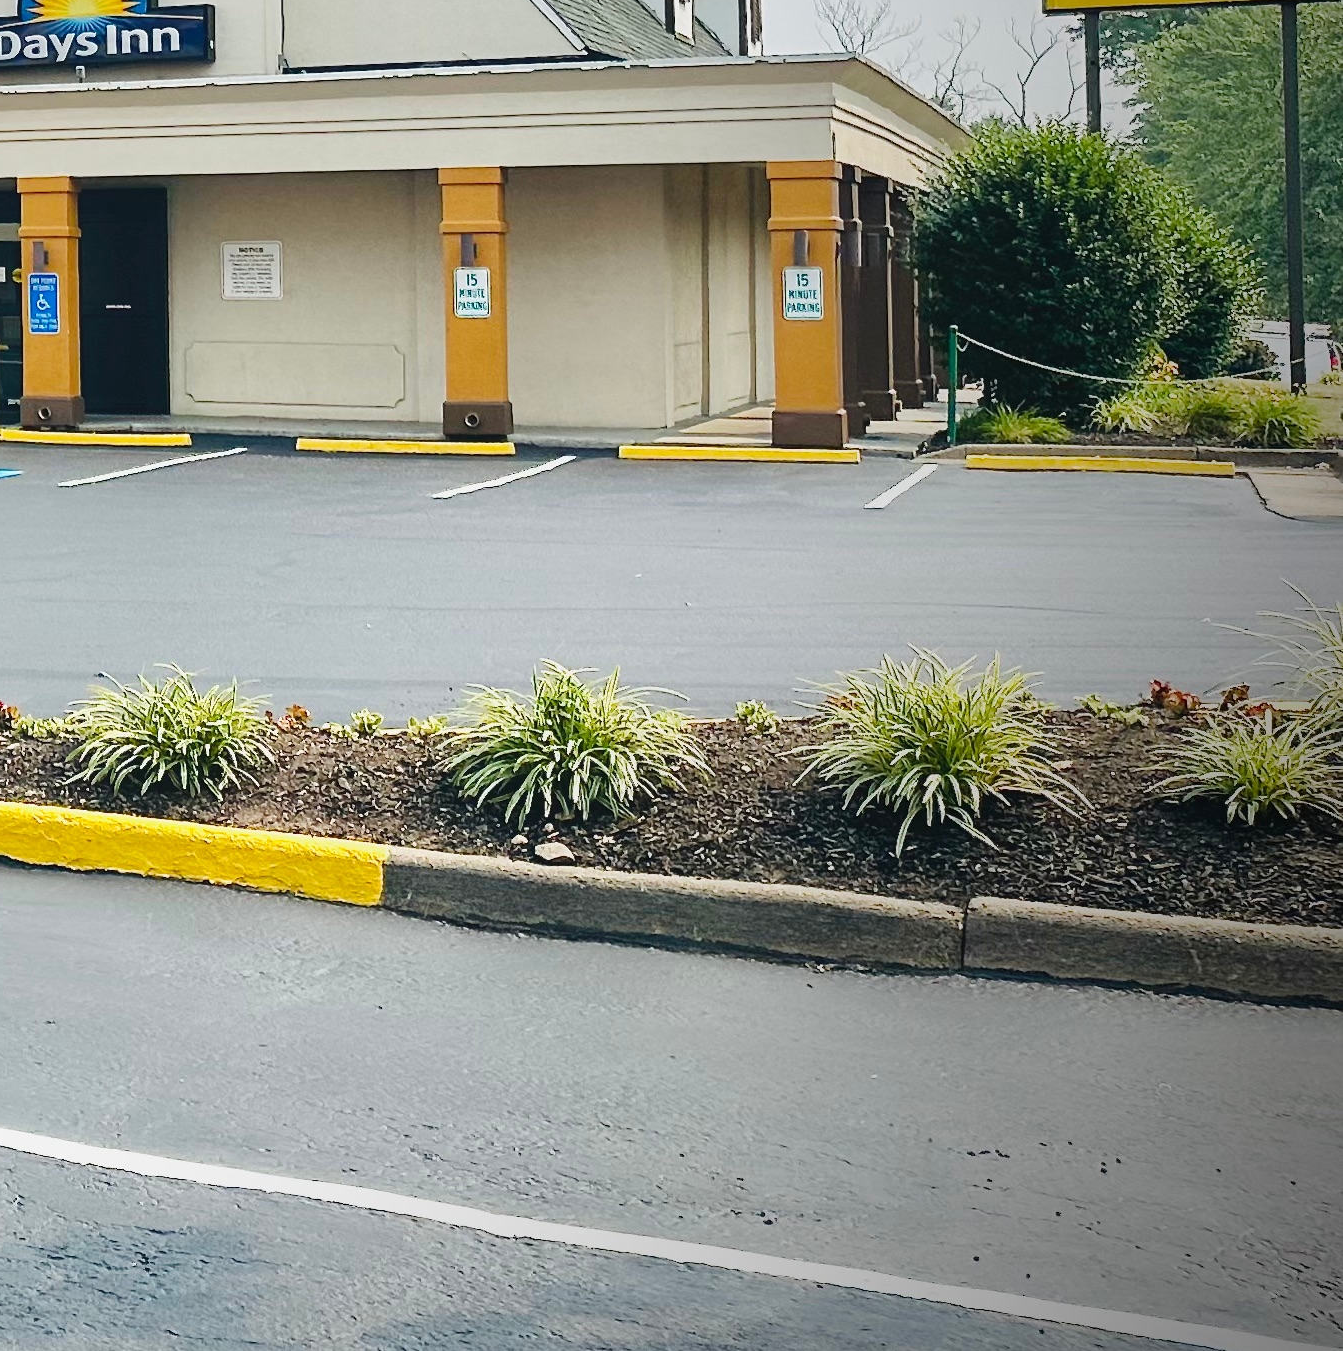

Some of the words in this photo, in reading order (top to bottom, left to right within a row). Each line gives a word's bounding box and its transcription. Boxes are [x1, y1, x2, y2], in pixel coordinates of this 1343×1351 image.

[105, 23, 182, 55] Inn
[466, 273, 478, 287] 15
[796, 273, 809, 287] 15
[459, 288, 485, 298] MINUTE
[788, 289, 818, 300] MINUTE
[458, 301, 487, 311] PARKING
[787, 302, 820, 313] PARKING
